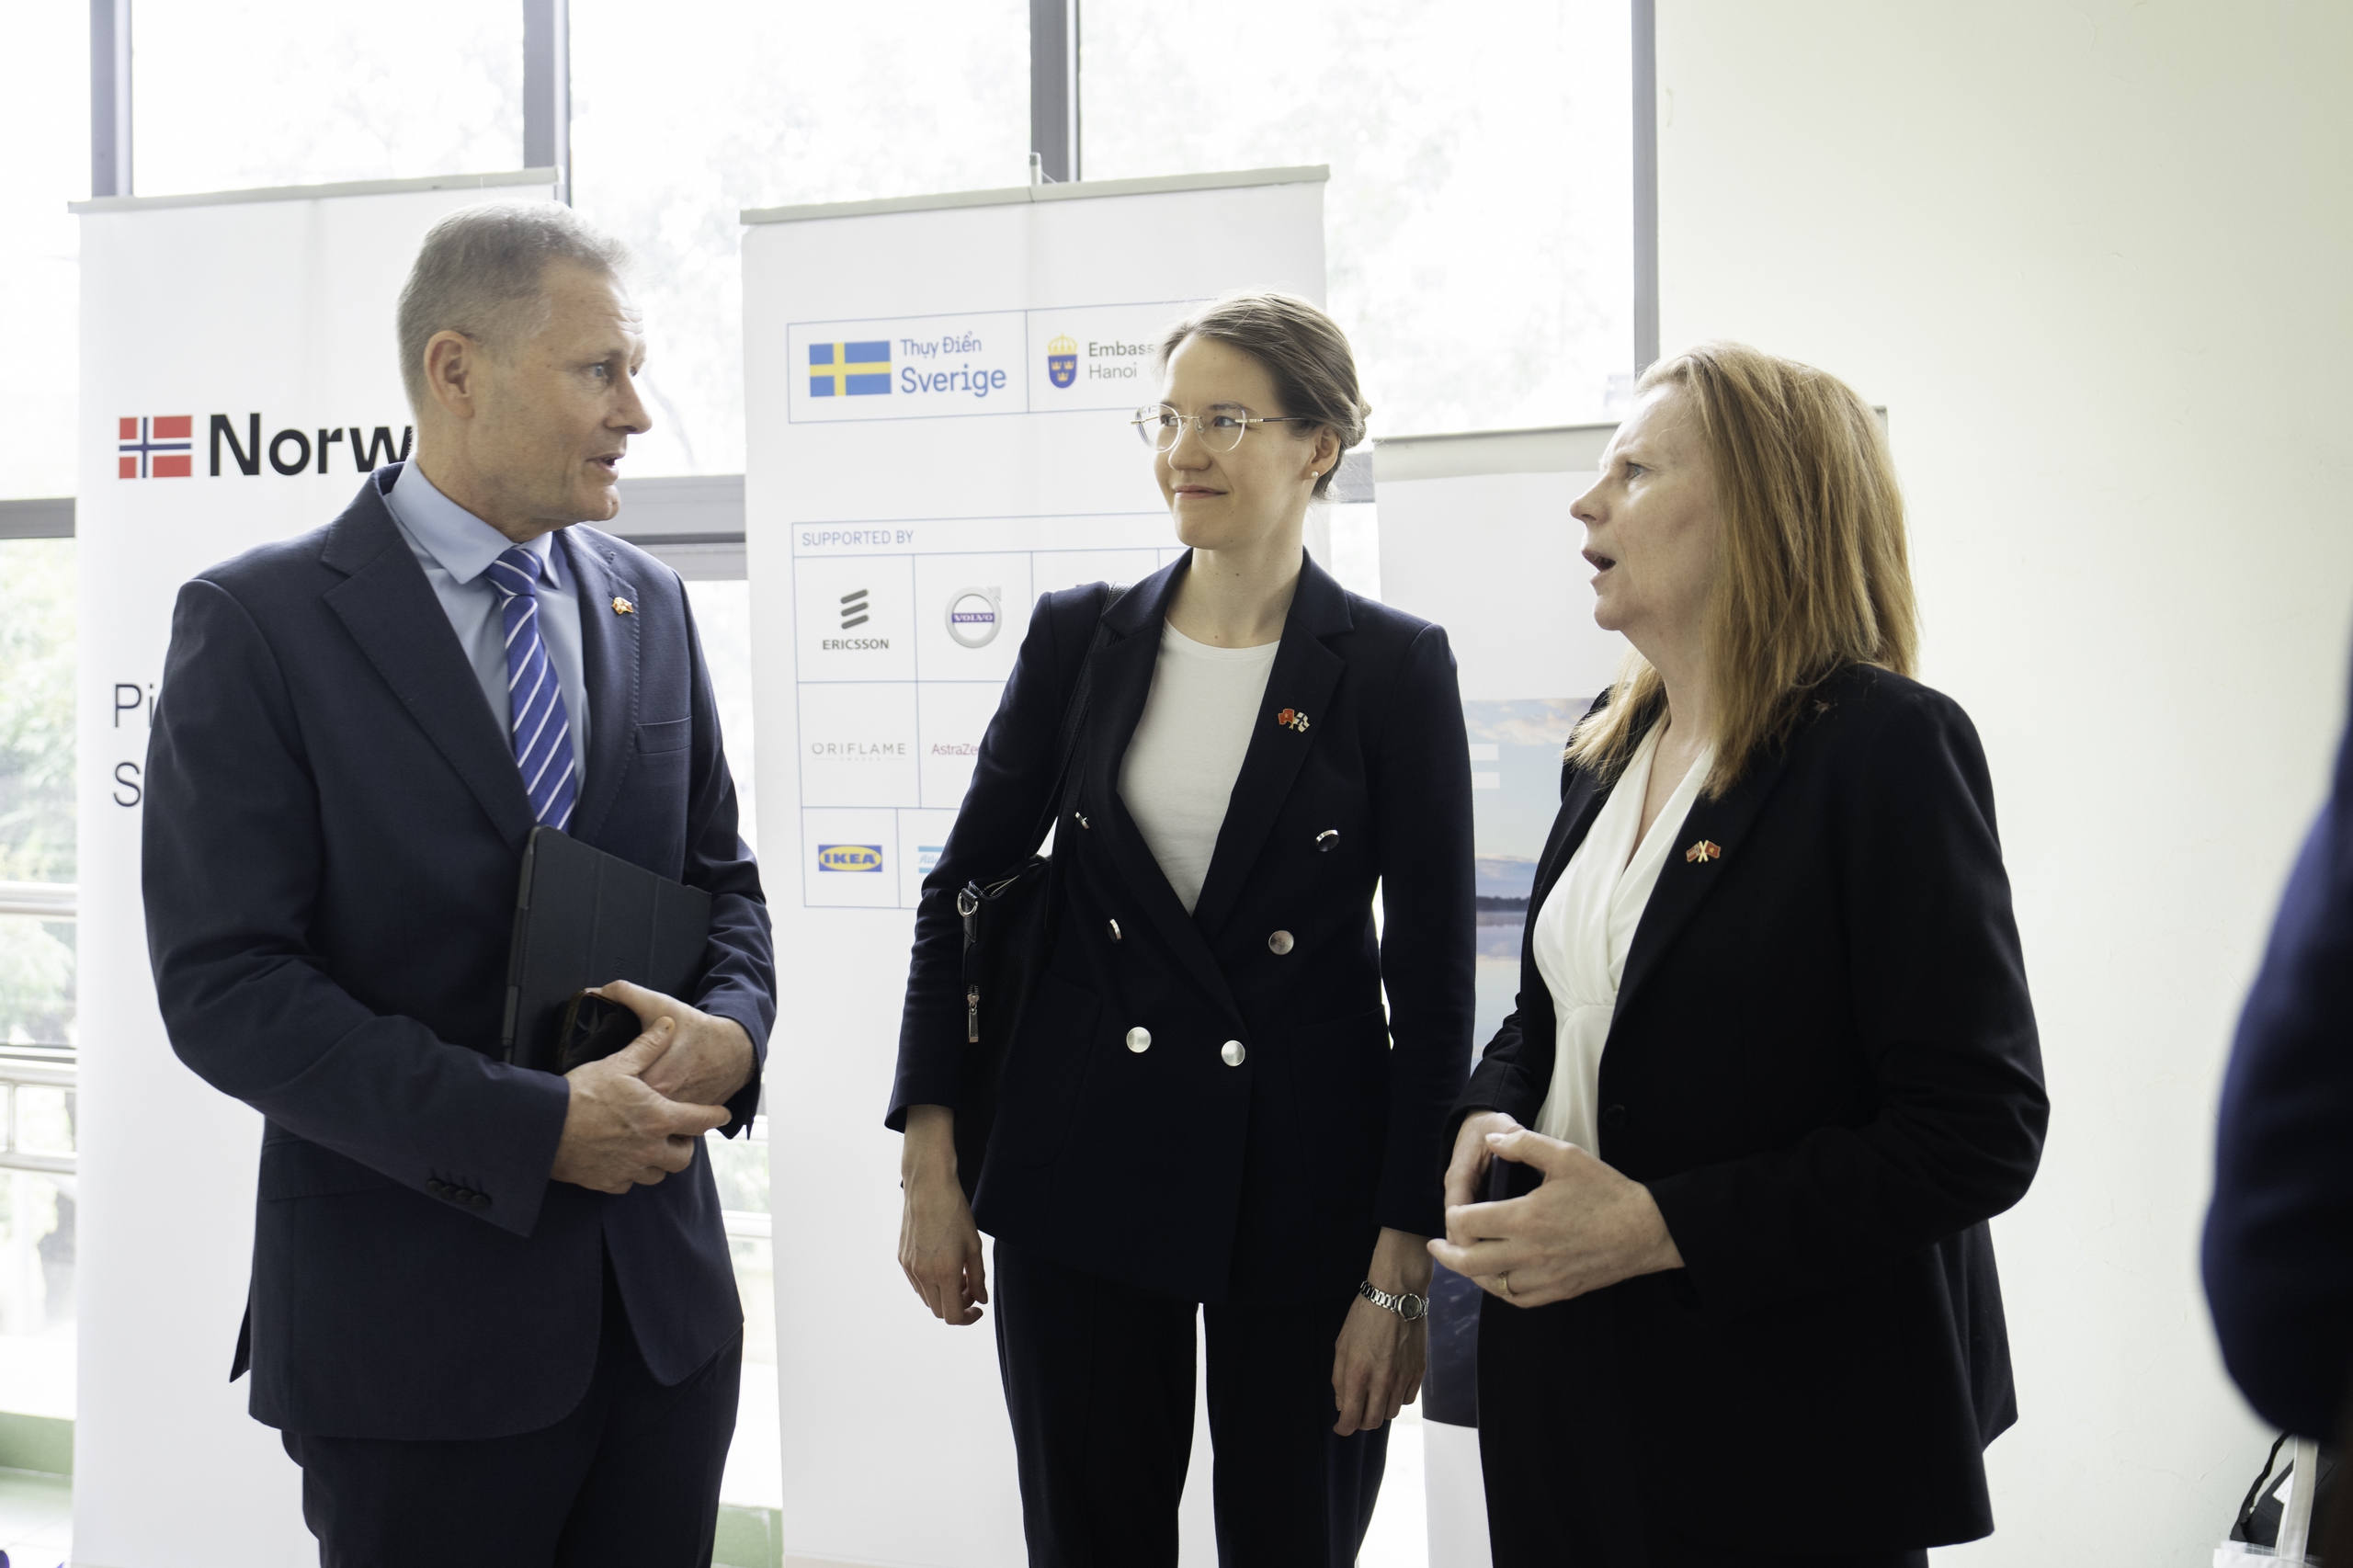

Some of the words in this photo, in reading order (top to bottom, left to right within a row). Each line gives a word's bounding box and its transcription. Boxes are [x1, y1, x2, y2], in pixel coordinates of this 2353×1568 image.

[1089, 361, 1138, 380] Hanoi
[901, 363, 1006, 397] Sverige
[210, 413, 413, 477] Norw
[801, 529, 892, 546] SUPPORTED
[895, 529, 915, 544] BY
[953, 613, 994, 622] VOLVO
[823, 638, 890, 651] ERICSSON
[812, 742, 907, 756] ORIFLAME
[824, 853, 876, 864] IKEA
